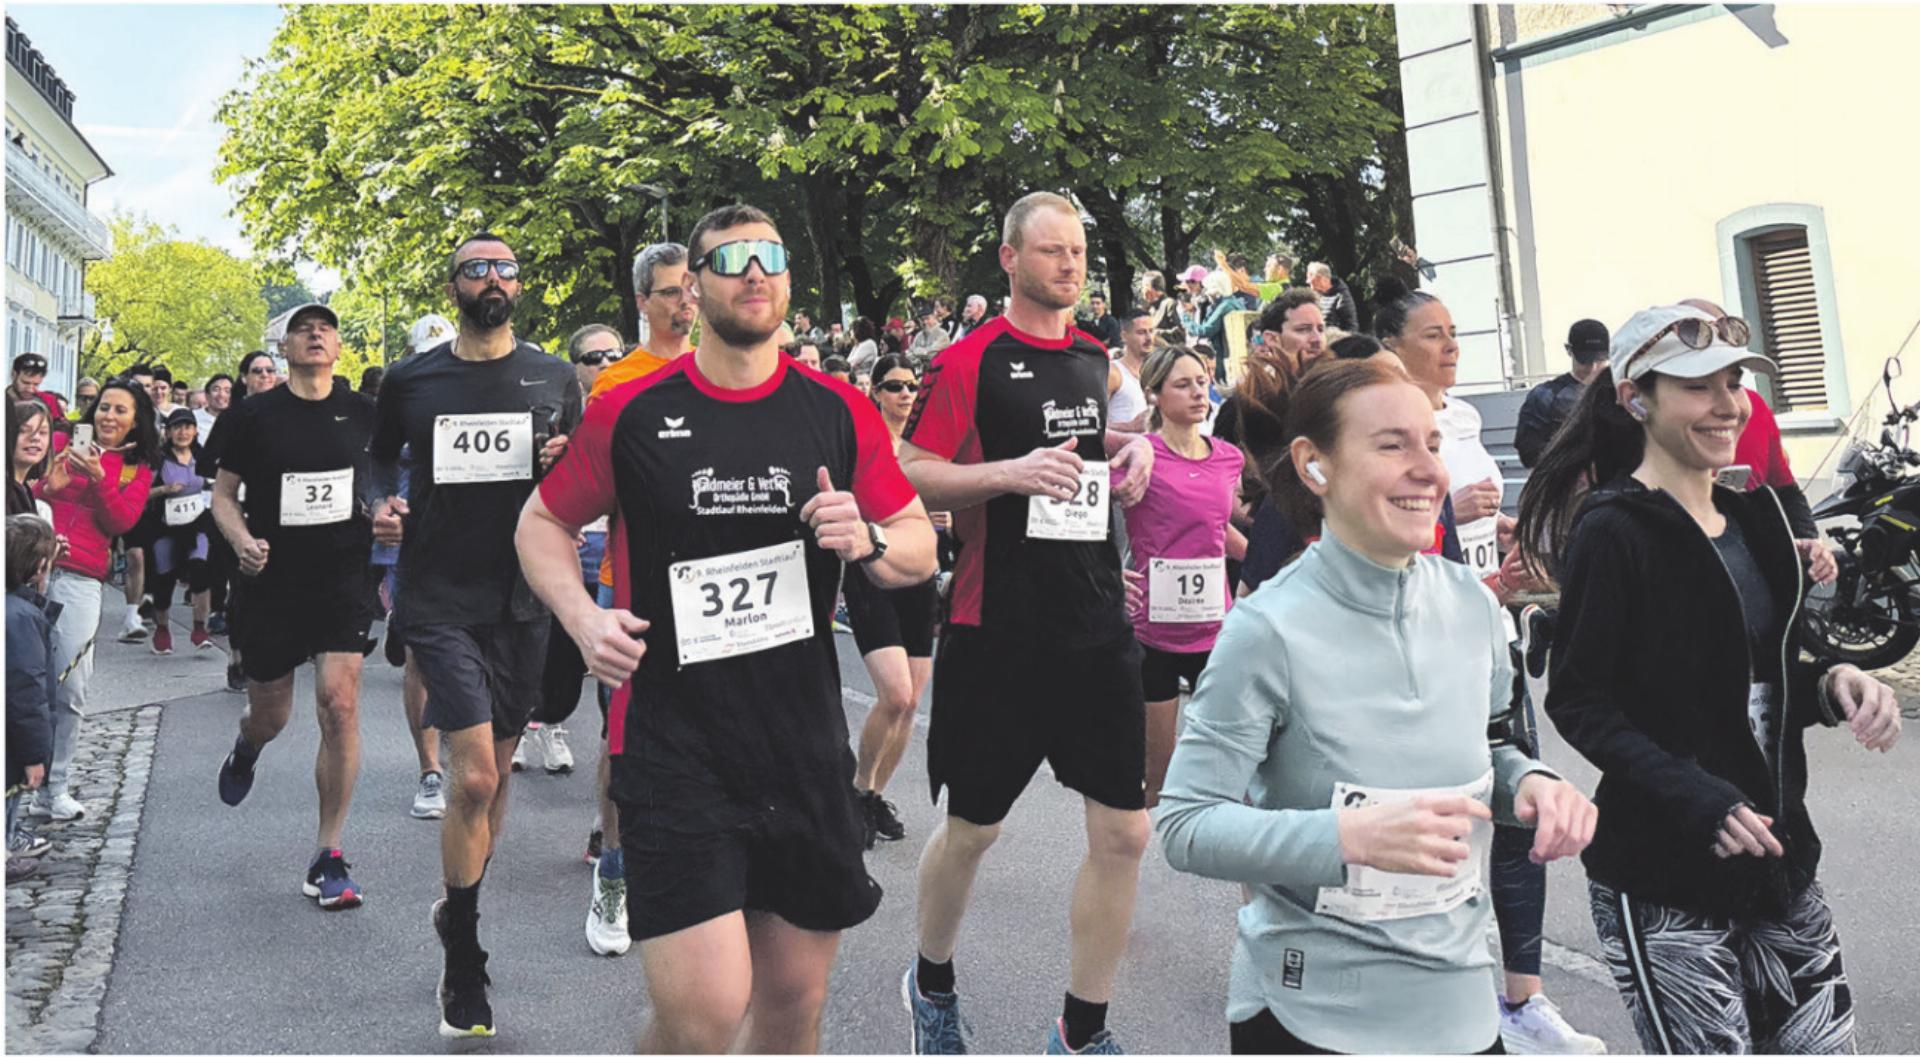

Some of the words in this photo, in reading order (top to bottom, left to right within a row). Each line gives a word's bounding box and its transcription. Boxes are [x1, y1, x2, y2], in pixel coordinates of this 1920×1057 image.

[453, 429, 511, 453] 406
[304, 484, 333, 503] 32
[748, 476, 756, 491] &
[1050, 480, 1099, 507] 28
[173, 502, 196, 513] 411
[696, 504, 735, 515] Stadtlauf
[736, 502, 787, 514] Rheinfelden
[1065, 508, 1089, 519] Diego
[705, 560, 758, 575] Rheinfelden
[760, 549, 797, 566] Stadtlauf
[1462, 541, 1494, 568] 107
[700, 571, 778, 617] 327
[1177, 573, 1205, 596] 19
[724, 612, 768, 629] Marlon
